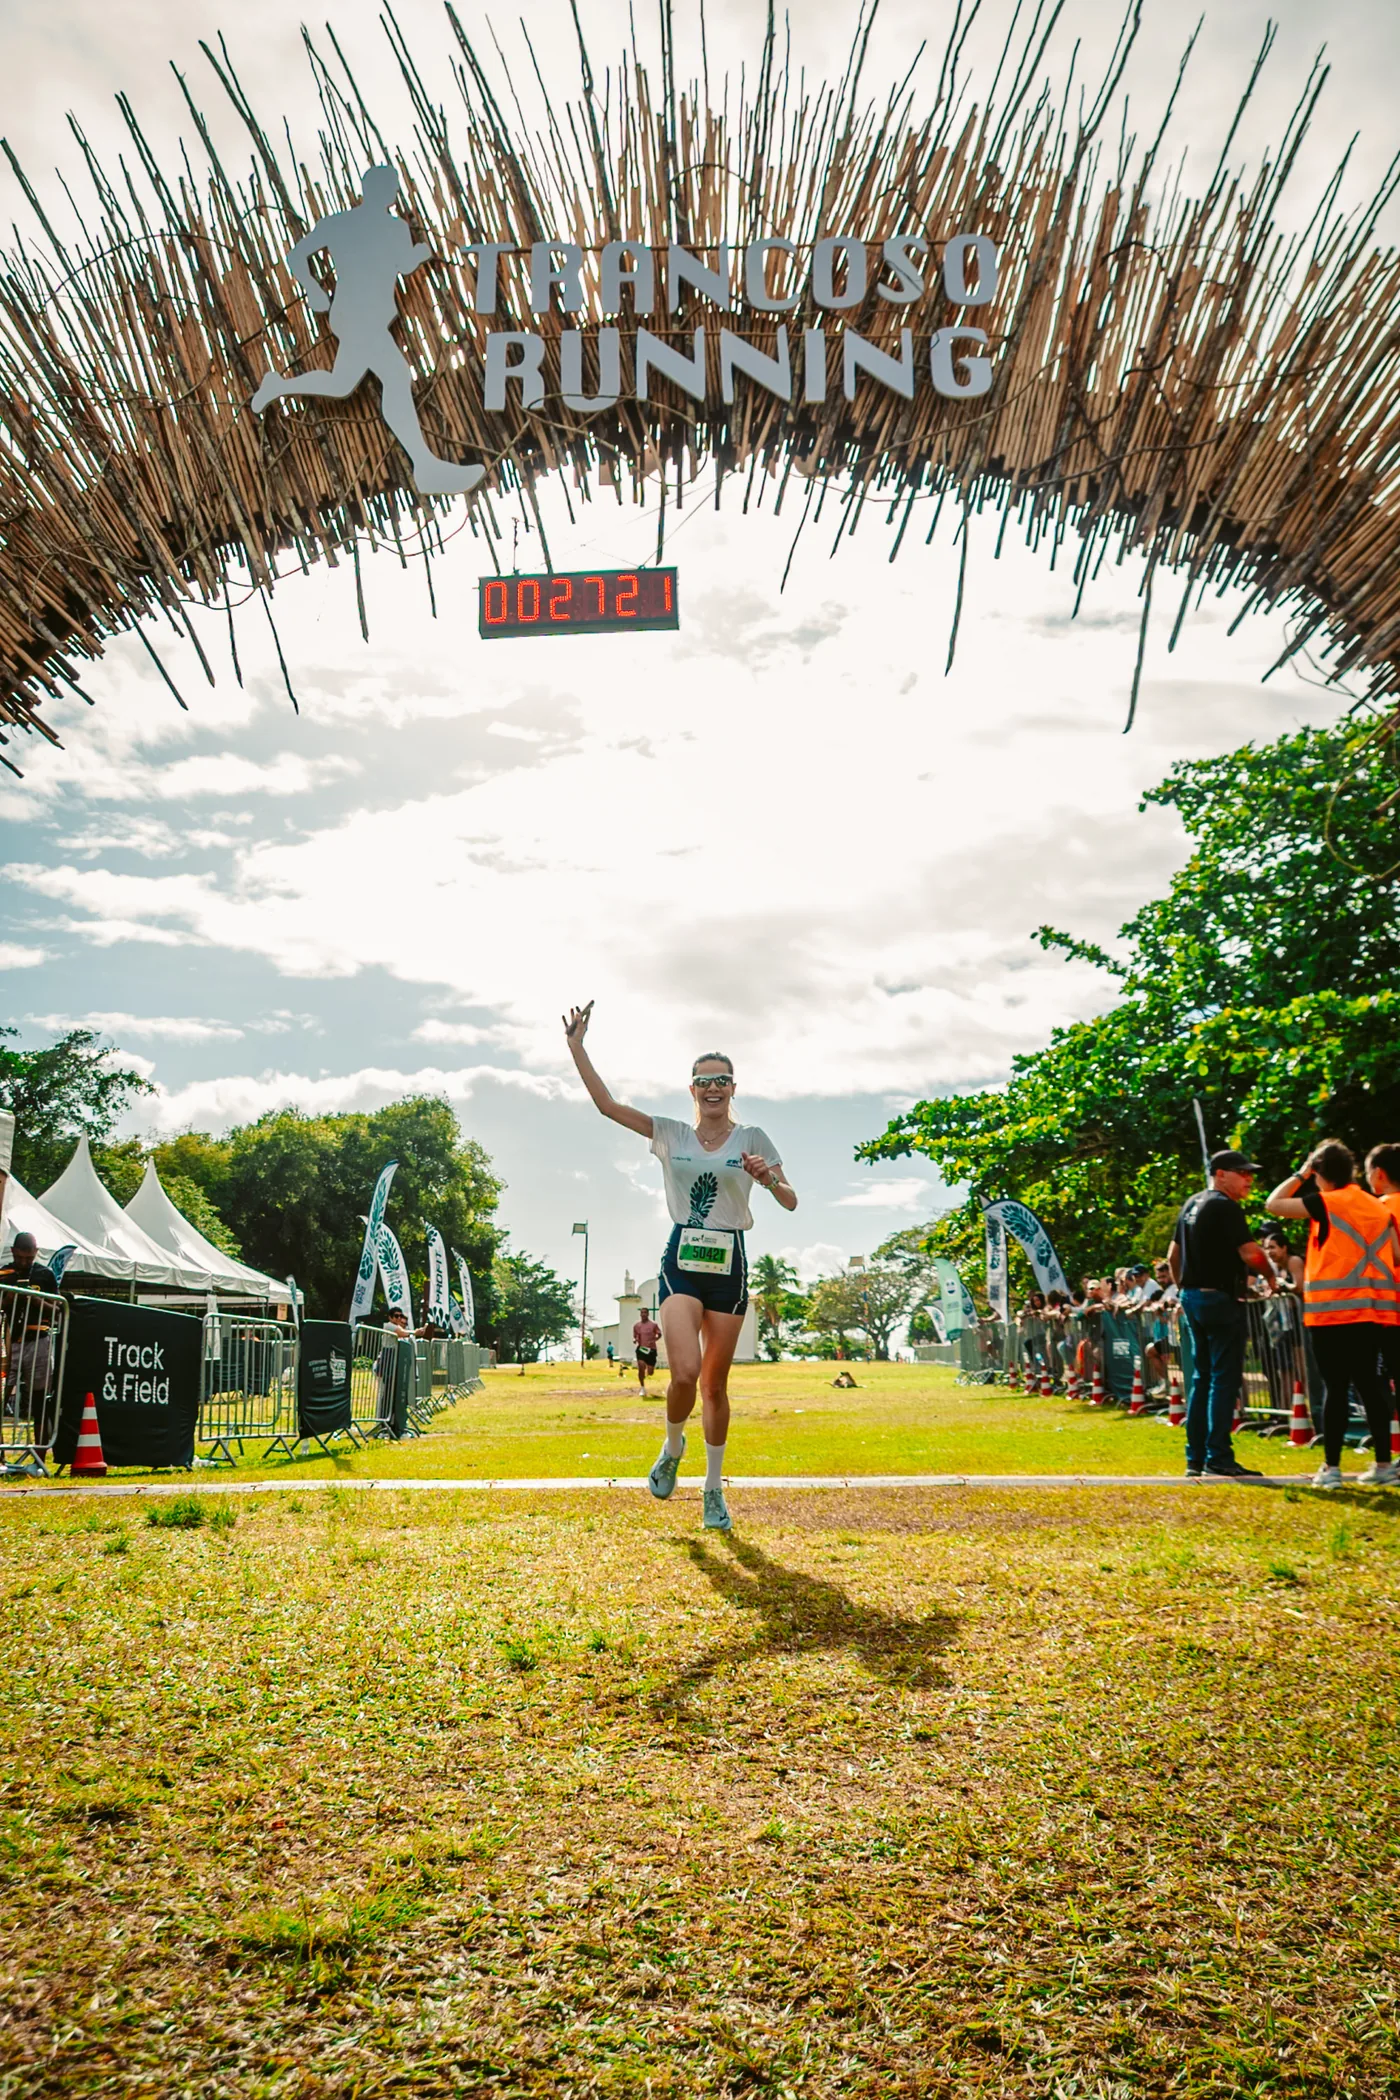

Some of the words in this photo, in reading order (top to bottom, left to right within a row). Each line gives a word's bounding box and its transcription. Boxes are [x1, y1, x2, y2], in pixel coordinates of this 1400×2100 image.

[460, 233, 1000, 315] TRANCOSO
[484, 324, 994, 412] RUNNING
[692, 1245, 725, 1261] 50421
[434, 1249, 443, 1305] PROFIT
[104, 1336, 165, 1370] Track
[102, 1371, 118, 1401] &
[122, 1373, 170, 1405] Field
